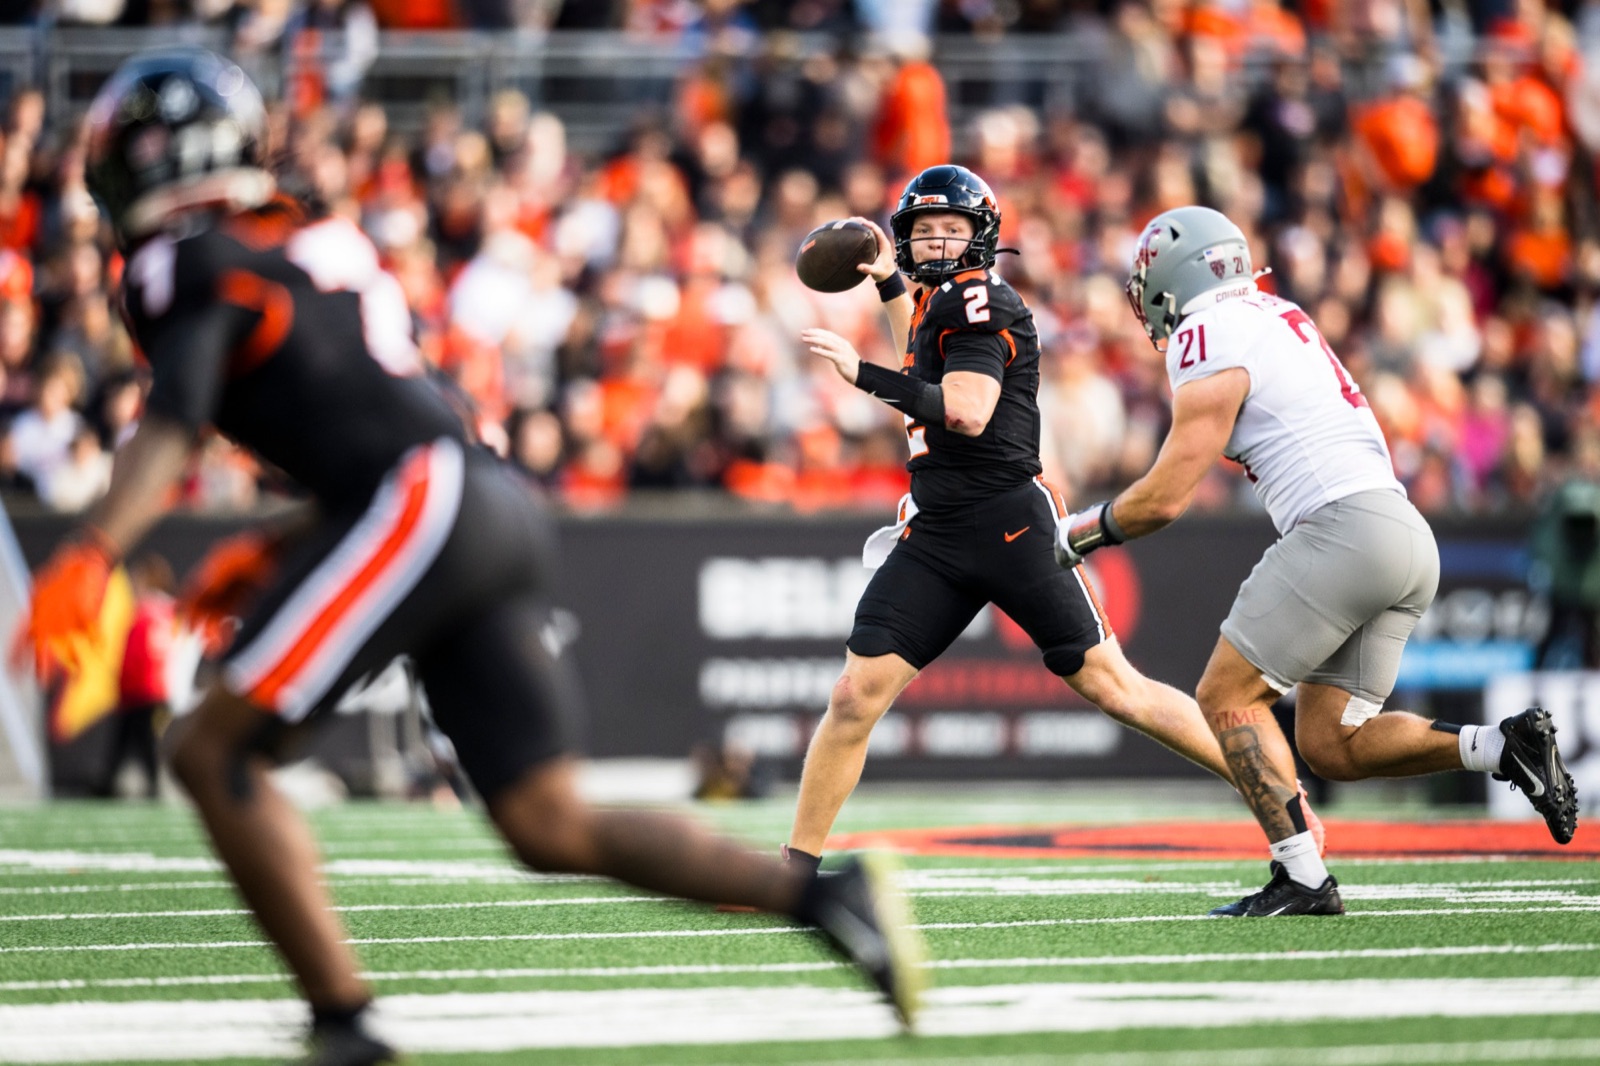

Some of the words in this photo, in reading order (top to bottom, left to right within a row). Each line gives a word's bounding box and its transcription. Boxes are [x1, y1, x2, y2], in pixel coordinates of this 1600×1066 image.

[1233, 256, 1244, 275] 21
[963, 285, 991, 324] 2
[1216, 286, 1250, 303] COUGARS
[1177, 324, 1207, 369] 21
[1211, 708, 1266, 731] TIME
